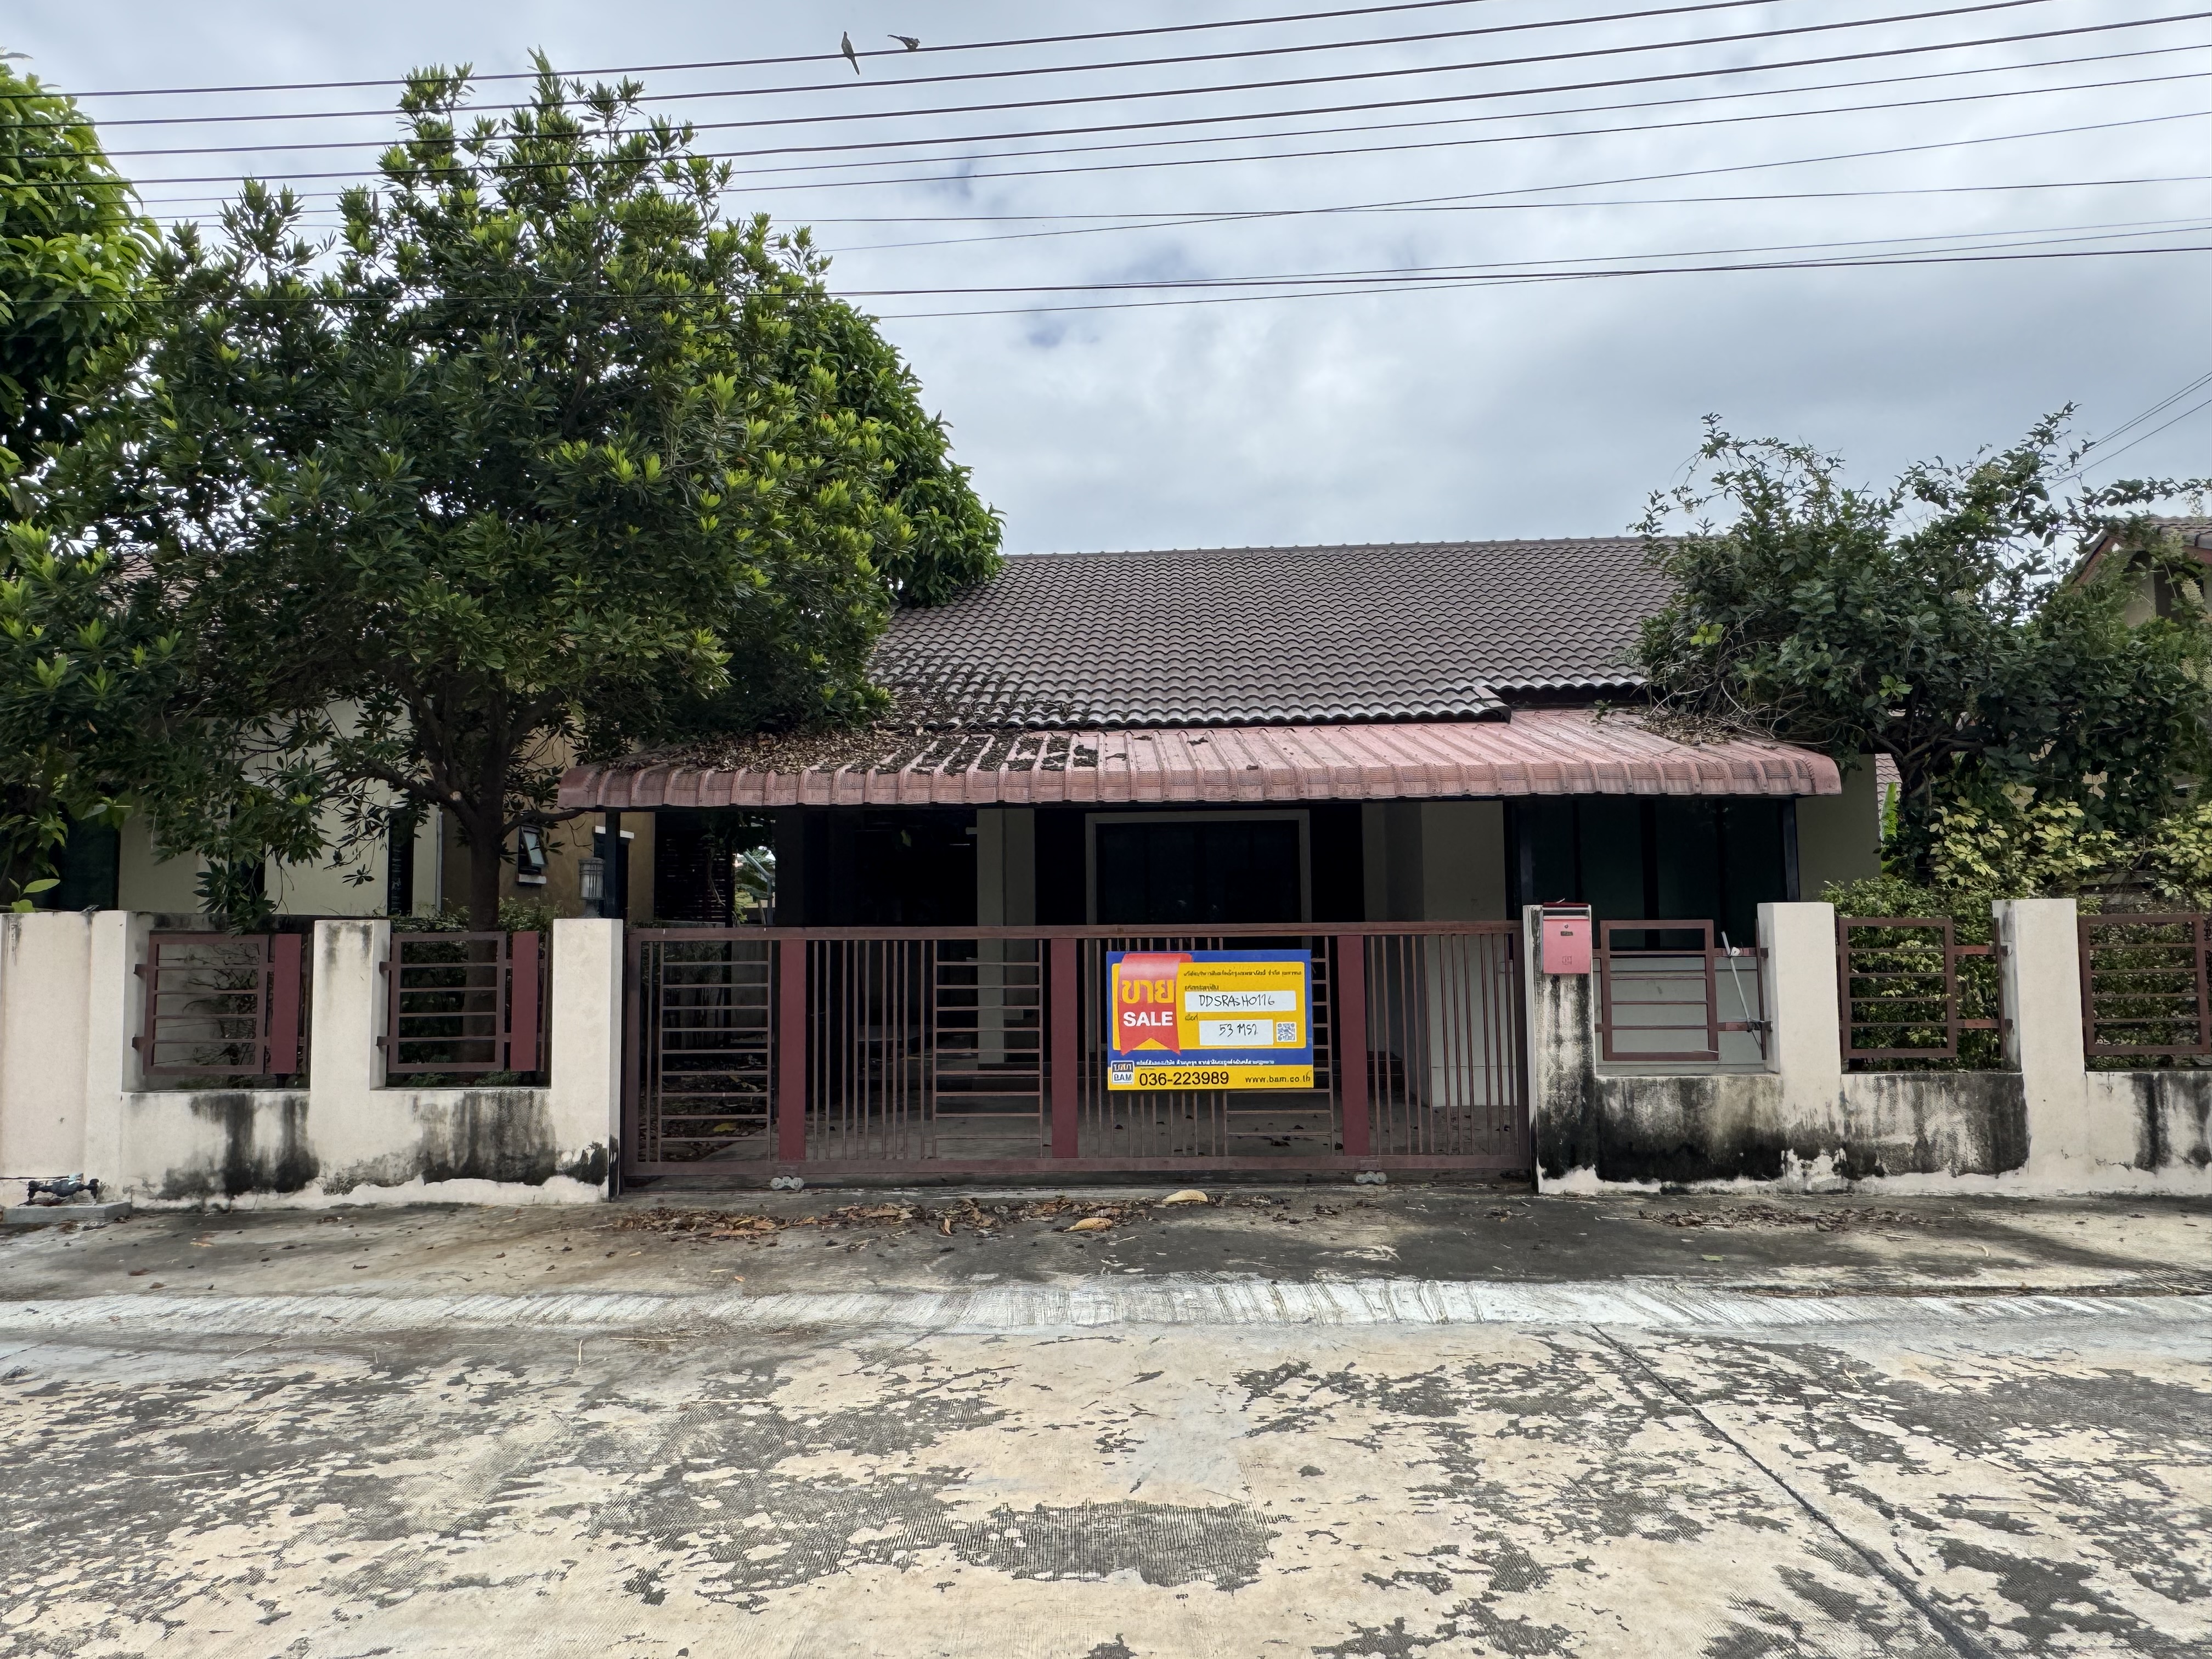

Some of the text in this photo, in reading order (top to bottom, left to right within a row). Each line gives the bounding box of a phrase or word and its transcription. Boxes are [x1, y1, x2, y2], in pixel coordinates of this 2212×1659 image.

[1121, 979, 1174, 1004] ขาย
[1123, 1011, 1173, 1026] SALE
[1219, 1023, 1233, 1037] 53
[1139, 1071, 1229, 1086] 036-223989
